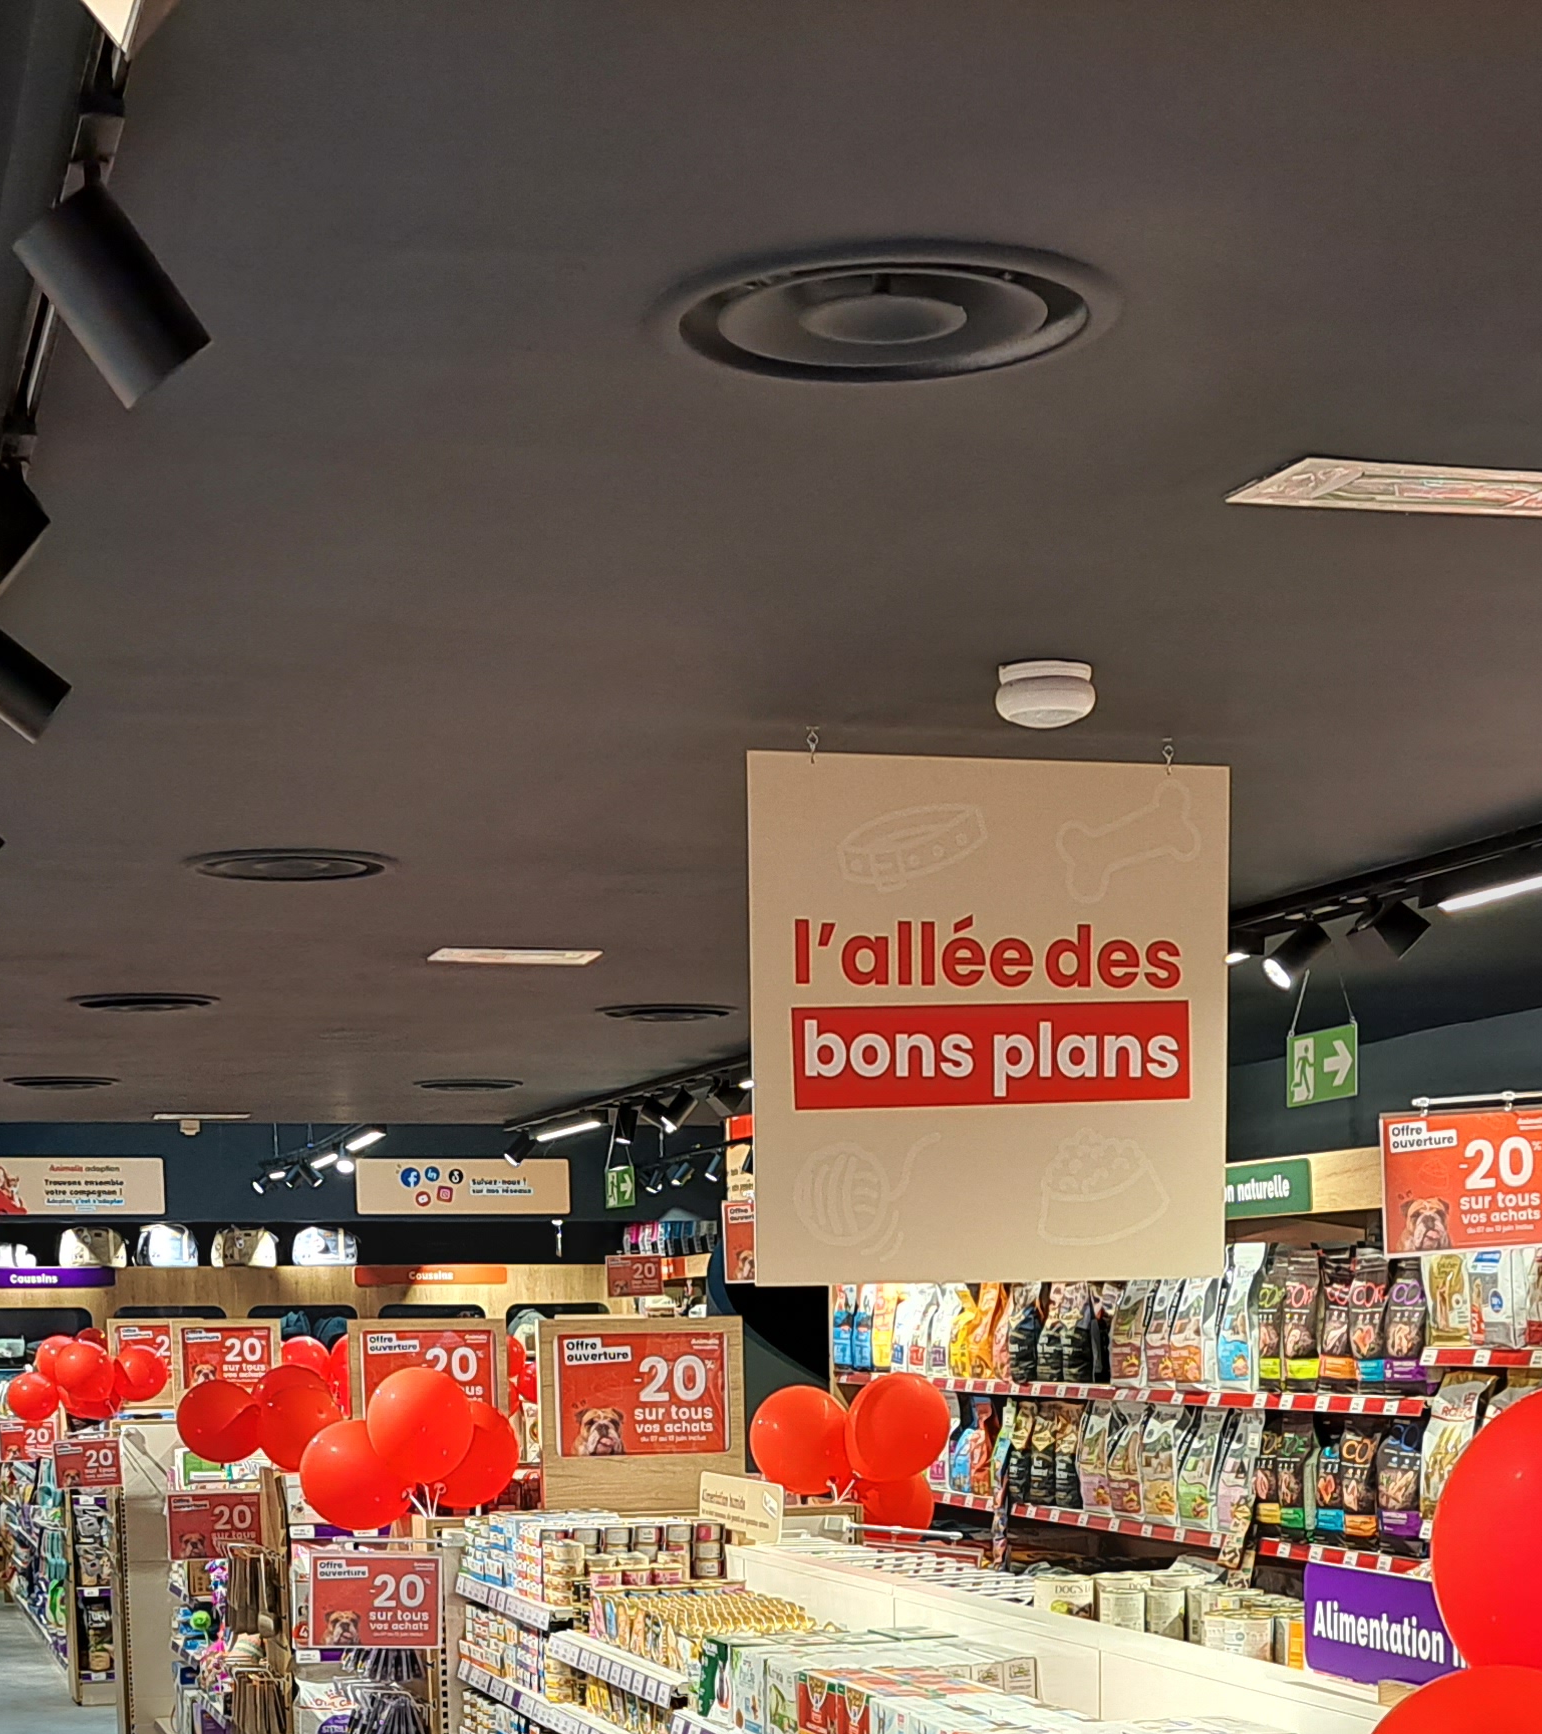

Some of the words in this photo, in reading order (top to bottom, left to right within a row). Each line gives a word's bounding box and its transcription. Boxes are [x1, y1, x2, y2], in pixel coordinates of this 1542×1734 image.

[794, 914, 1034, 988] l'allée
[1045, 923, 1181, 989] des
[804, 1019, 975, 1079] bons
[993, 1020, 1180, 1098] plans
[1391, 1124, 1422, 1137] Offre
[1392, 1134, 1454, 1149] ouverture
[1237, 1174, 1290, 1202] naturelle
[1460, 1196, 1491, 1210] sur
[1496, 1191, 1540, 1208] tous
[1461, 1213, 1488, 1224] vos
[1490, 1209, 1541, 1222] achats
[10, 1273, 58, 1285] Coussins
[409, 1269, 454, 1281] Coussins
[369, 1335, 393, 1344] Offre
[566, 1340, 597, 1351] Offre
[566, 1349, 629, 1362] ouverture
[633, 1408, 667, 1421] sur
[670, 1404, 713, 1420] tous
[635, 1422, 660, 1433] vos
[663, 1420, 714, 1433] achats
[319, 1561, 343, 1570] Offre
[319, 1568, 367, 1577] ouverture
[369, 1611, 394, 1621] sur
[396, 1610, 429, 1621] tous
[369, 1622, 388, 1631] vos
[391, 1621, 429, 1631] achats
[1313, 1600, 1445, 1664] Alimentation
